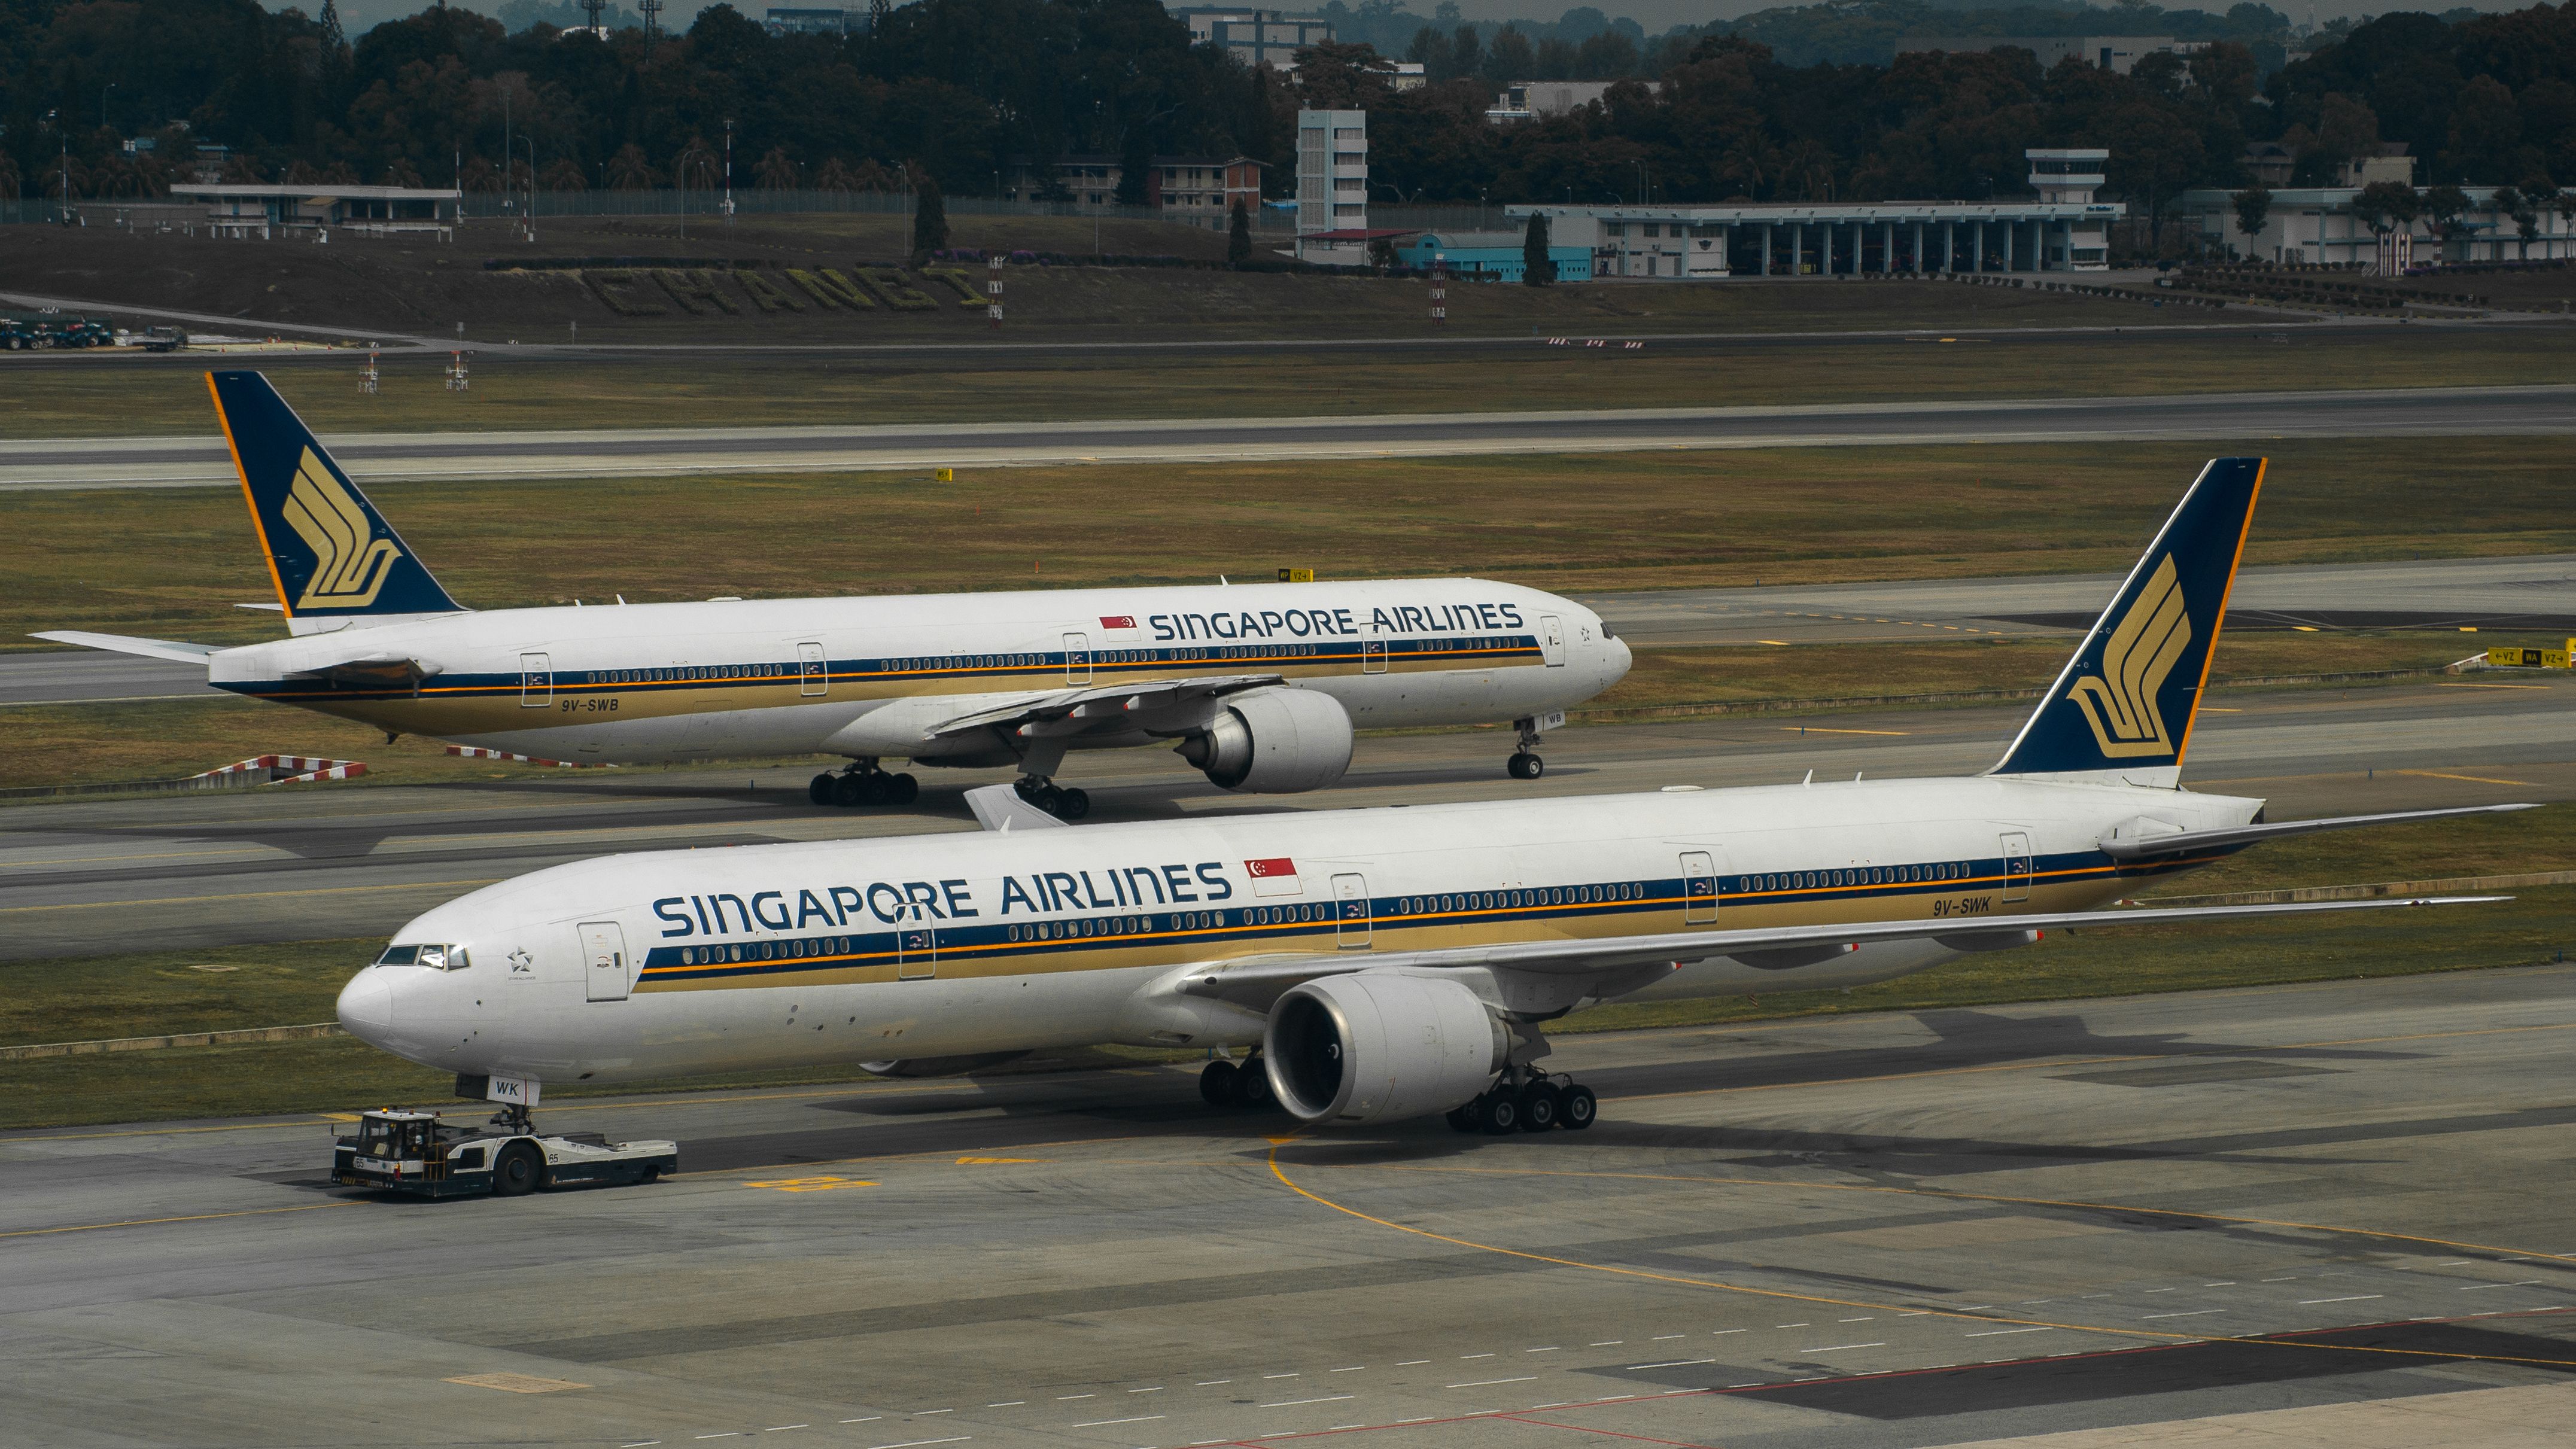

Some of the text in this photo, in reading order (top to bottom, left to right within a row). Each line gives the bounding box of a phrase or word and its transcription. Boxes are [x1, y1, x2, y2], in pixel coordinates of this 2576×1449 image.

[583, 267, 994, 316] CHANGI
[1149, 604, 1523, 641] SINGAPORE AIRLINES
[2503, 652, 2556, 663] VZ WA VZ
[561, 698, 619, 713] 9V-SWB
[1549, 714, 1561, 724] WB
[652, 862, 1233, 939] SINGAPORE AIRLINES
[1933, 896, 1992, 917] 9V-SWK
[496, 1080, 519, 1097] WK
[356, 1158, 364, 1168] 65
[549, 1153, 559, 1164] 65
